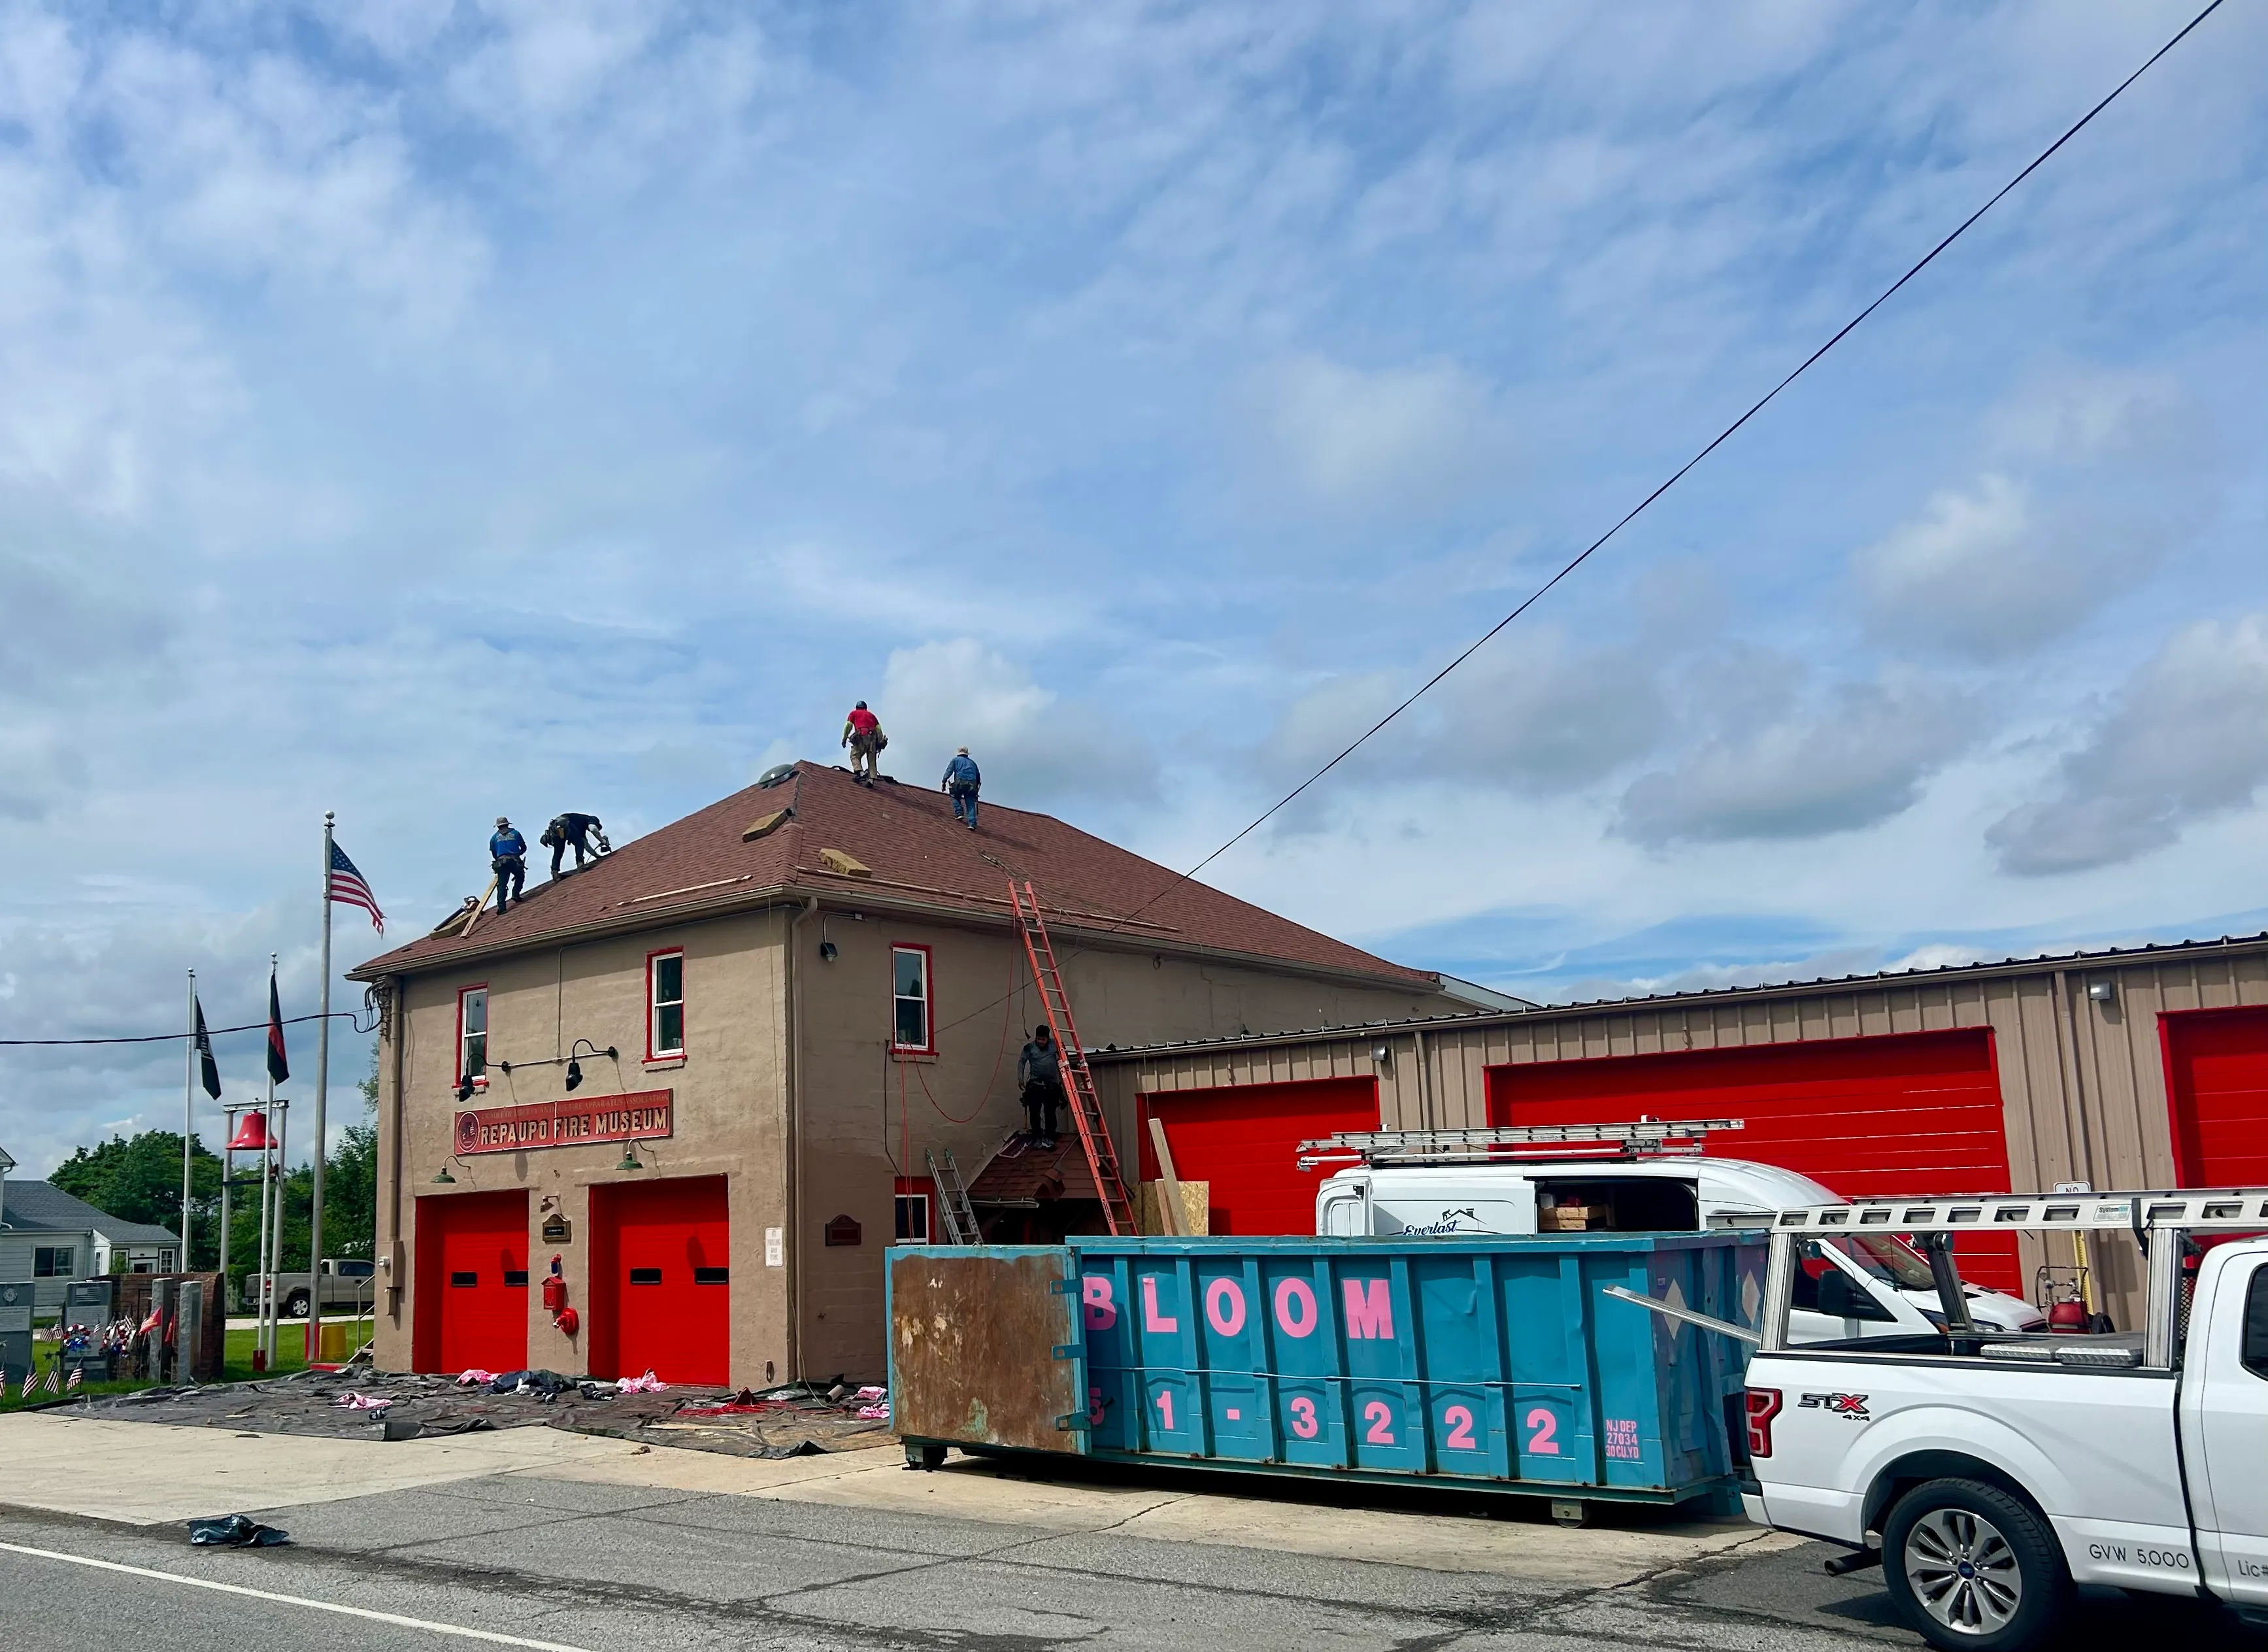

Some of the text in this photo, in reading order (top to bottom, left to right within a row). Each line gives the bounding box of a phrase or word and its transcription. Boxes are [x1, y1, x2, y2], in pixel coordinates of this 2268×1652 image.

[480, 1119, 548, 1145] REPAUPO
[554, 1117, 590, 1139] FIRE
[595, 1108, 667, 1135] MUSEUM
[1403, 1220, 1461, 1236] Everlast
[1082, 1276, 1394, 1340] BLOOM
[1797, 1392, 1870, 1414] STX
[1606, 1419, 1637, 1433] NJ DEP
[1607, 1432, 1638, 1445] 27034
[2090, 1544, 2189, 1568] GVW 5,000
